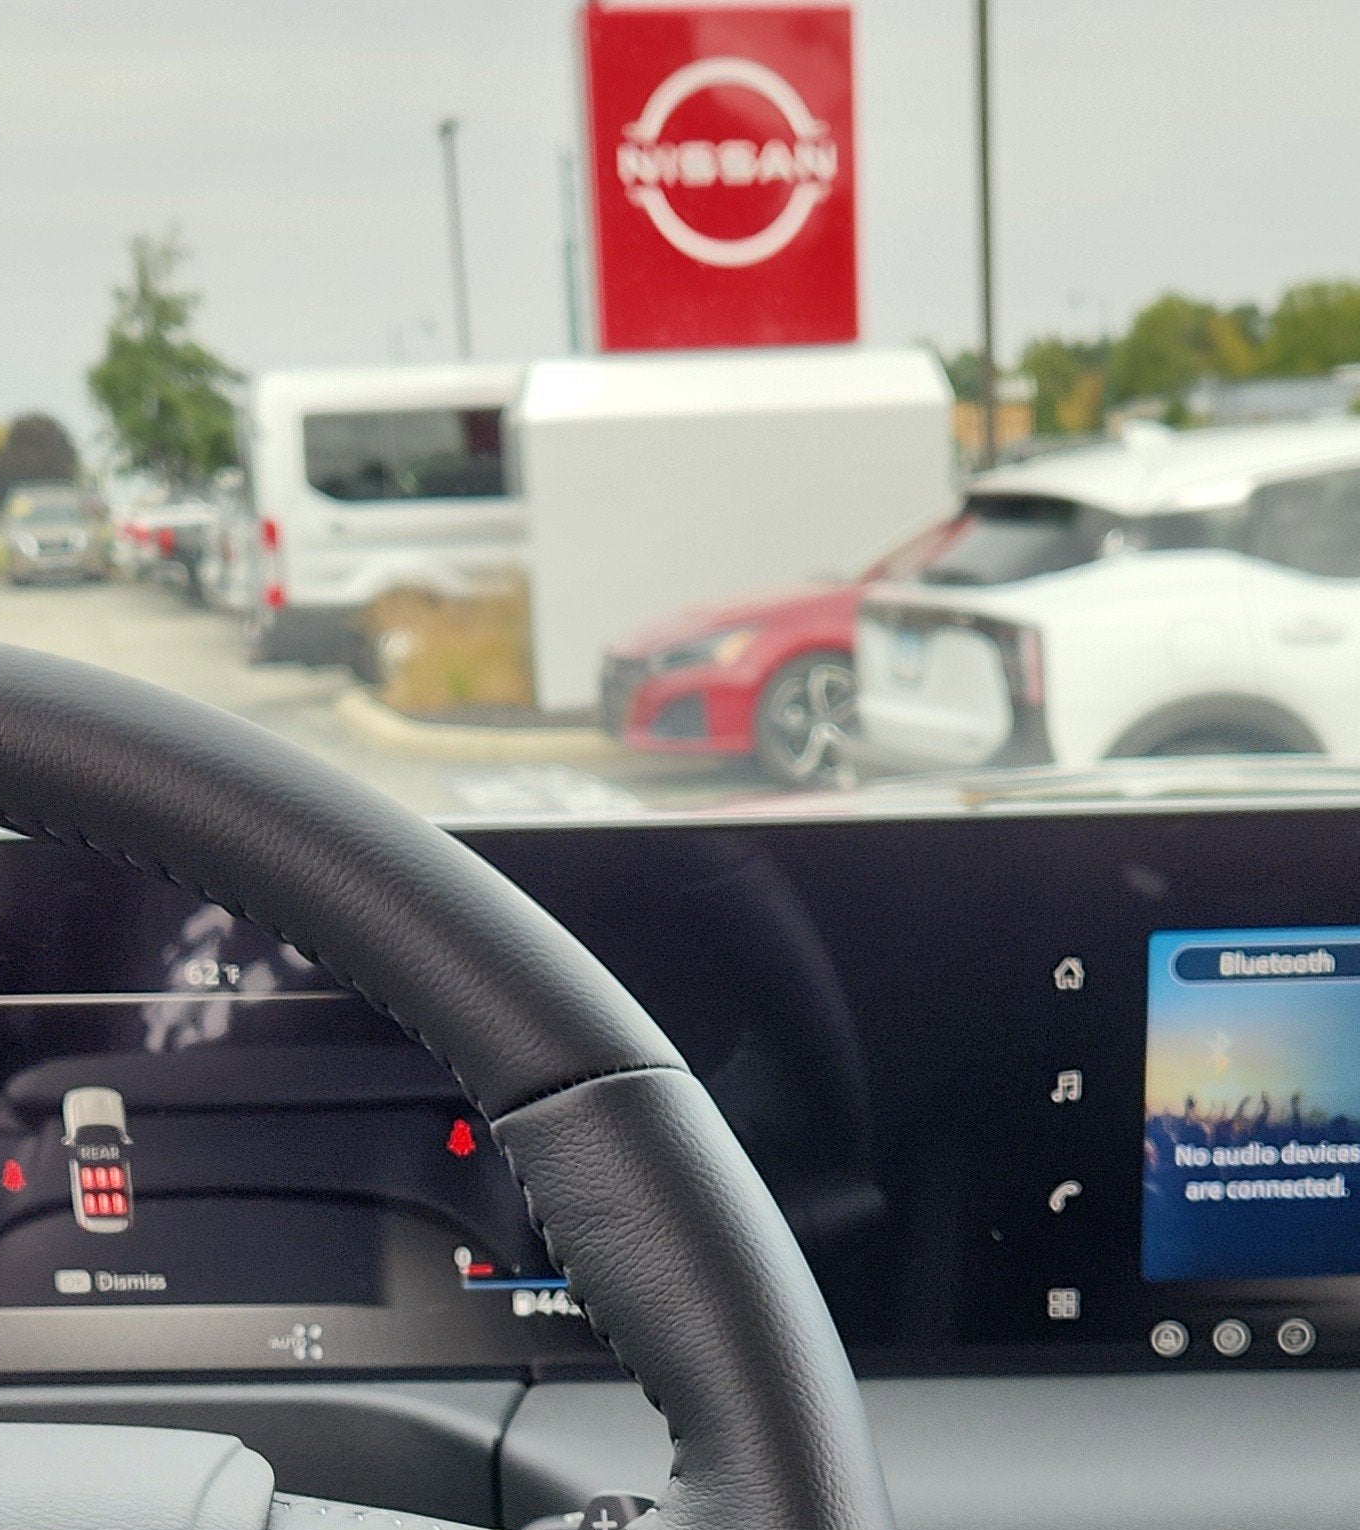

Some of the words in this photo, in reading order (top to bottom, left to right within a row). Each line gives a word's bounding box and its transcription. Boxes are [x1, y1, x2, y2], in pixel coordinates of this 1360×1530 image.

[616, 138, 837, 187] NISSAN
[1219, 949, 1336, 976] Bluetooth
[1174, 1144, 1211, 1167] No
[1212, 1142, 1279, 1166] audio
[1185, 1181, 1225, 1201] are
[1227, 1173, 1351, 1200] connected.
[95, 1269, 167, 1292] Dismiss
